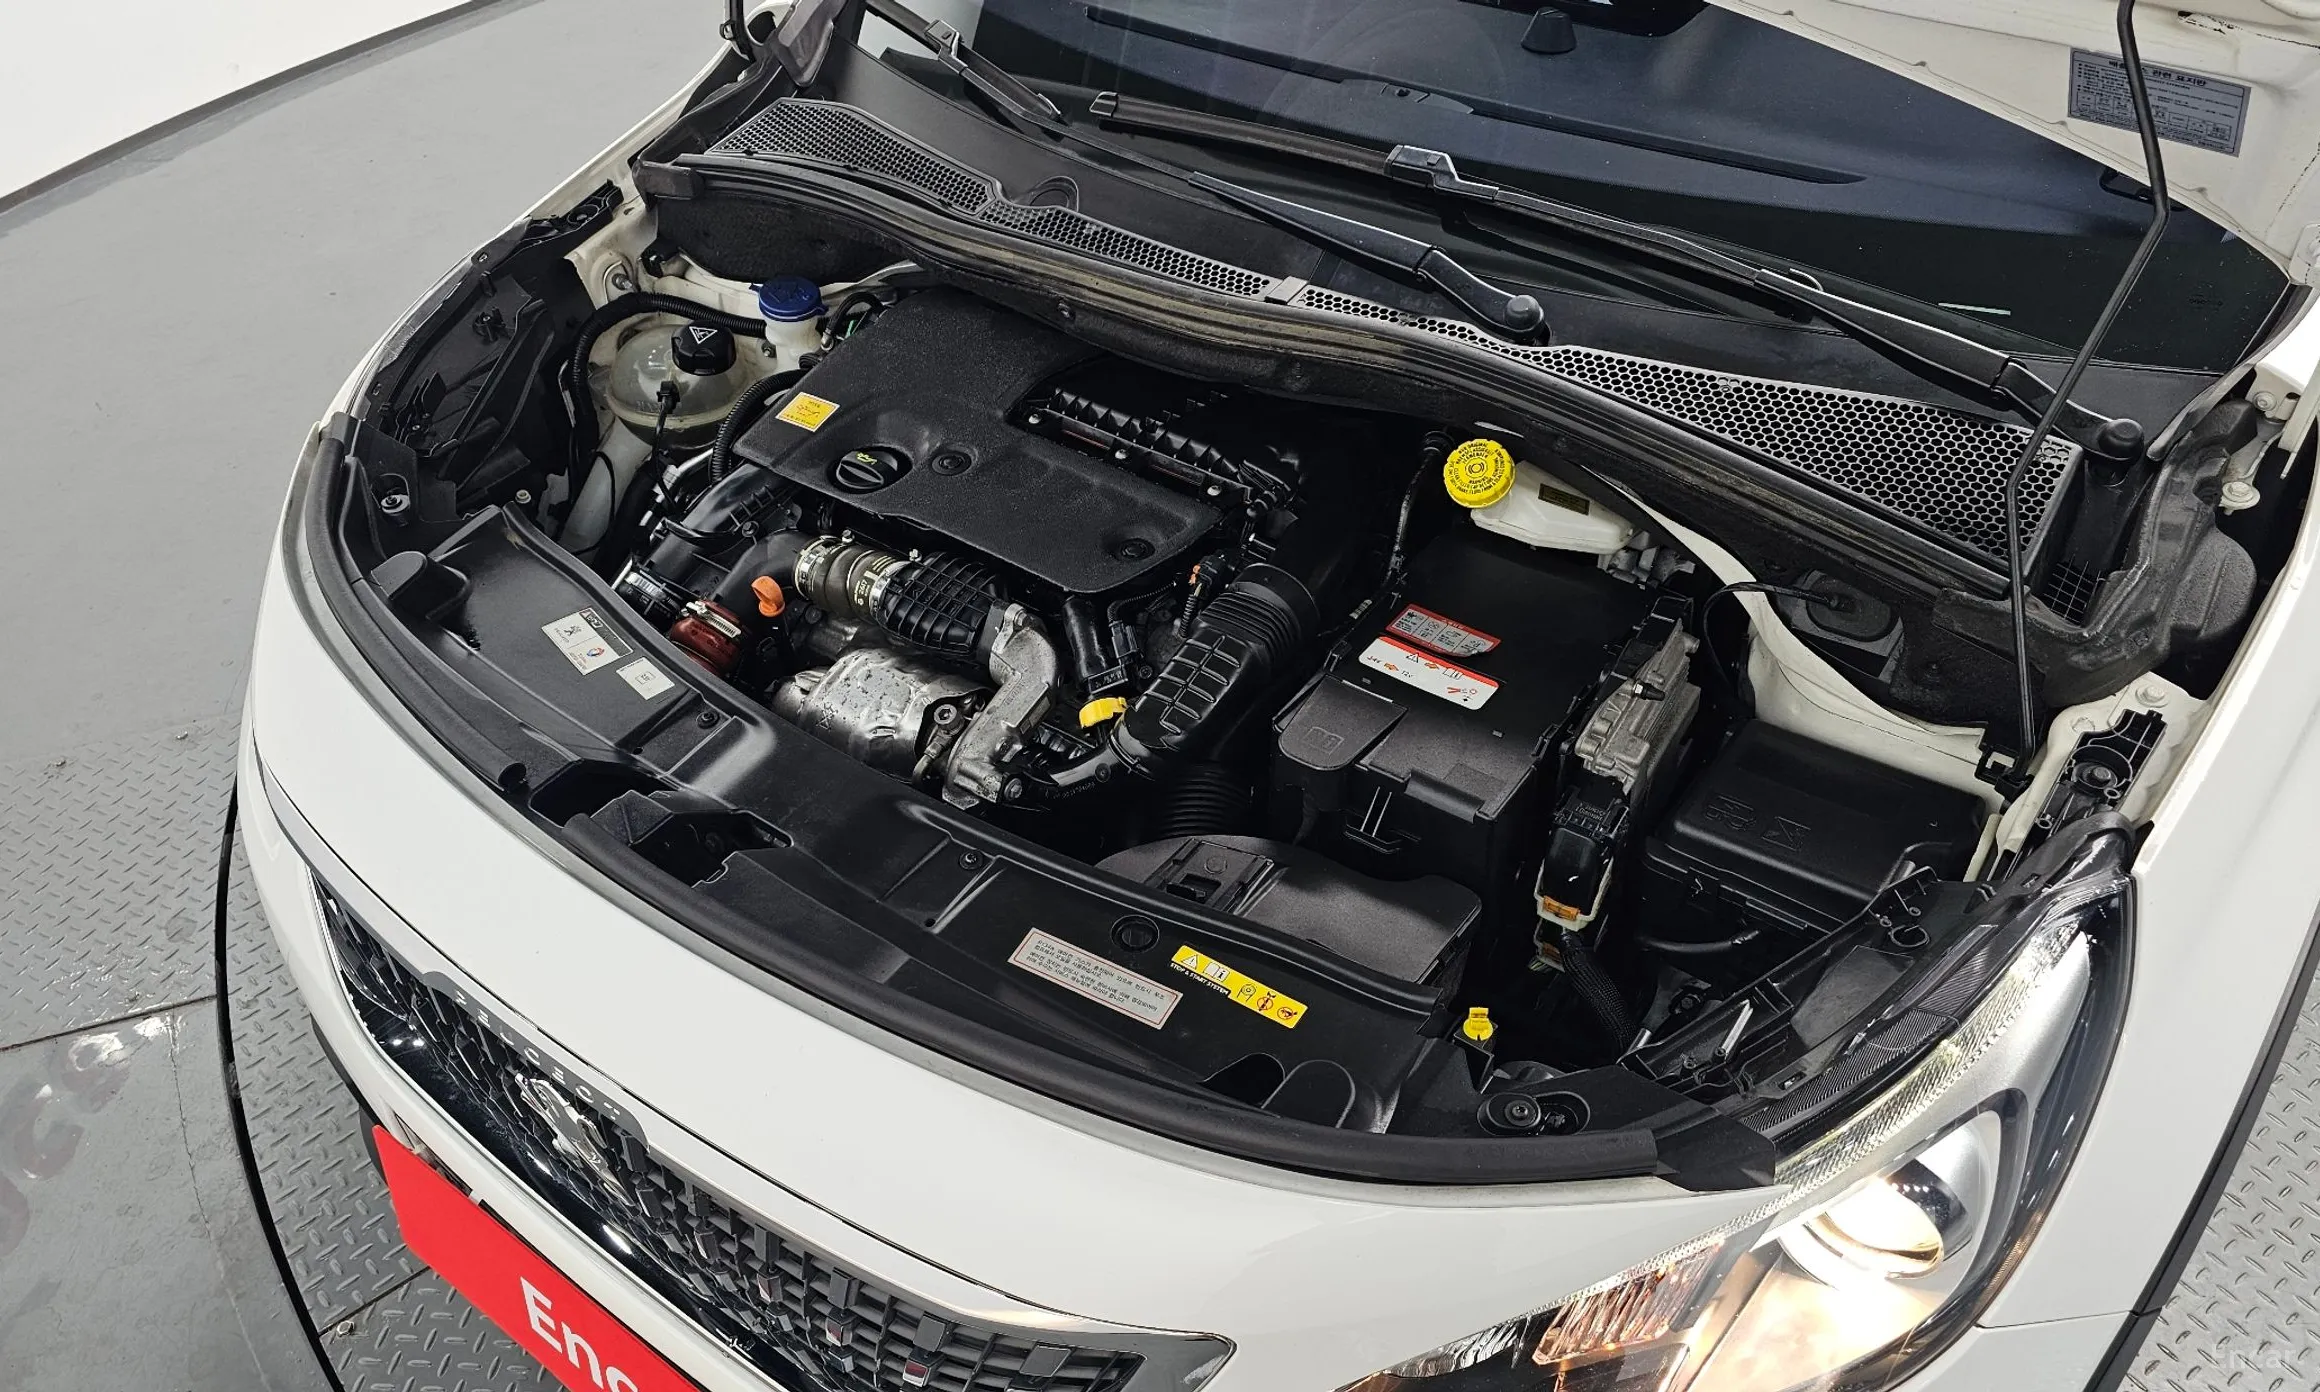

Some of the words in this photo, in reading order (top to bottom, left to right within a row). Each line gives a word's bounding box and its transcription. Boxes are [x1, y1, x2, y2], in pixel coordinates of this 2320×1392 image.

[2109, 60, 2148, 74] 배출스
[2152, 69, 2172, 80] 관련
[2177, 76, 2207, 87] 표지판
[1170, 962, 1186, 972] STOP
[1190, 972, 1208, 984] START
[1207, 982, 1229, 994] SYSTEM
